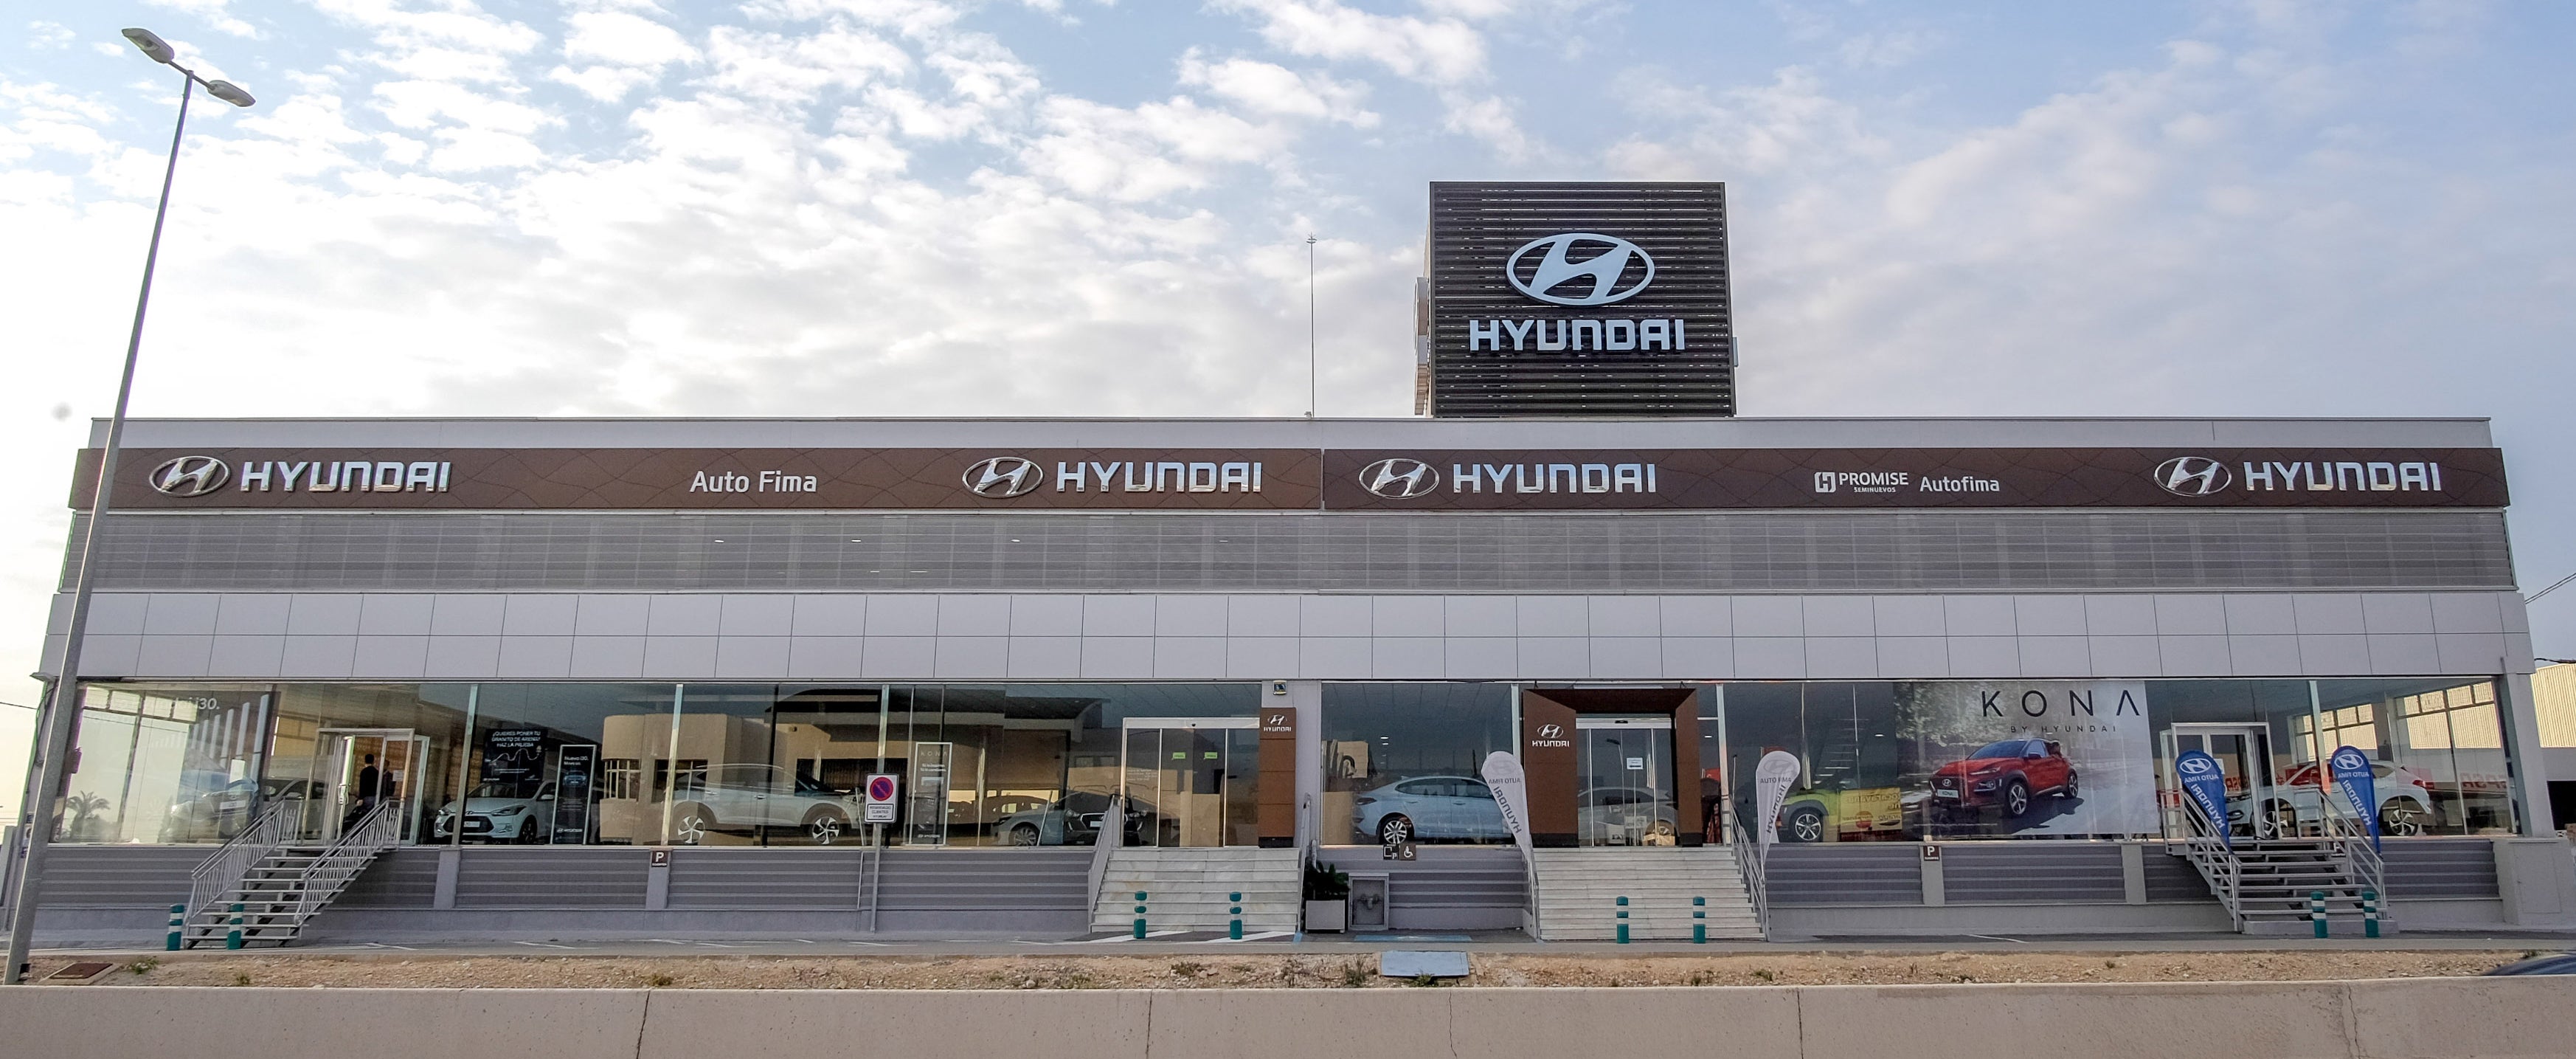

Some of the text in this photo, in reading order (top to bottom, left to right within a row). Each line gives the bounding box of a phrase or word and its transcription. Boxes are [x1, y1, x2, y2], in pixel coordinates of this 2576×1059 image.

[1469, 319, 1685, 351] HYUNDAI
[240, 461, 451, 492] HYUNDAI
[690, 470, 817, 494] Auto Fima
[1056, 462, 1263, 493] HYUNDAI
[1453, 463, 1657, 494] HYUNDAI
[1839, 472, 1908, 486] PROMISE
[1919, 477, 2000, 491] Autofima
[2244, 461, 2442, 491] HYUNDAI
[1981, 690, 2140, 717] KONA
[656, 852, 664, 862] P
[1927, 846, 1935, 856] P
